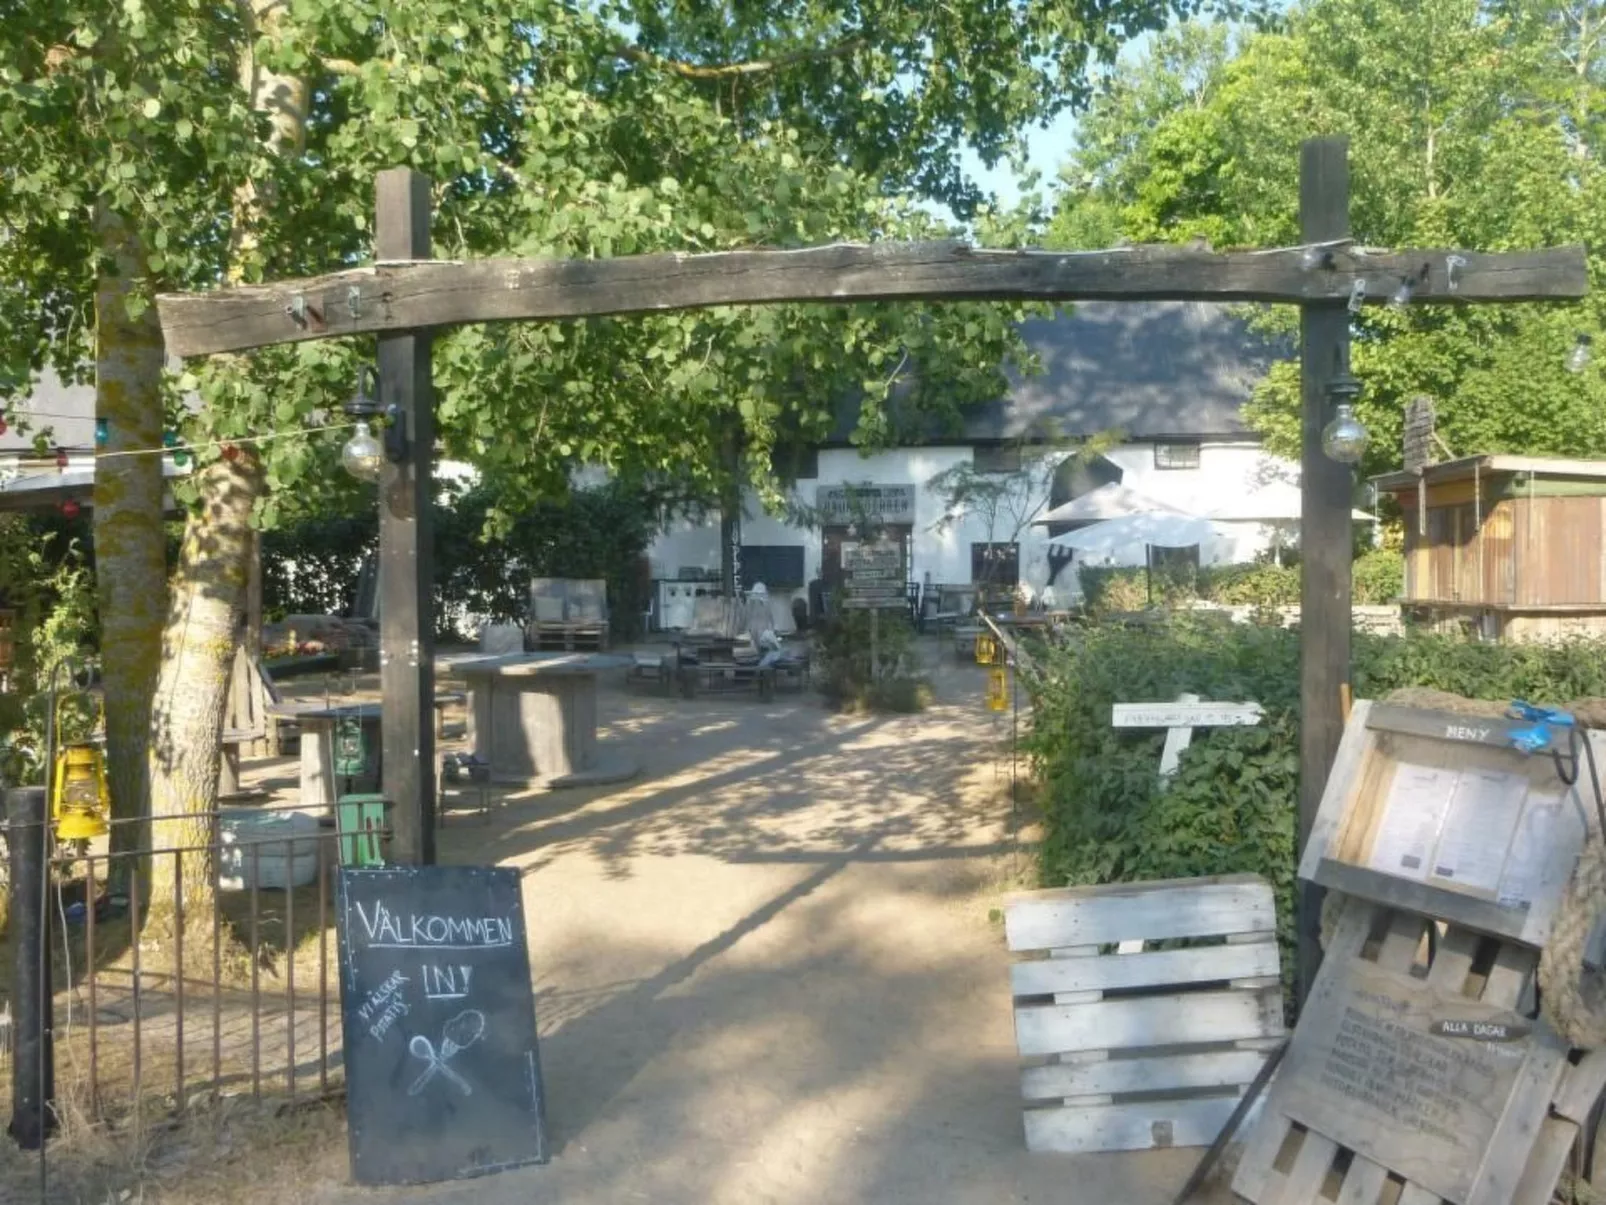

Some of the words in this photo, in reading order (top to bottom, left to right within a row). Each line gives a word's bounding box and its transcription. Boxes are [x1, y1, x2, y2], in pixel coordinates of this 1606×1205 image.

[1446, 725, 1490, 741] MENY
[356, 900, 513, 944] VÄLKOMMEN
[422, 965, 473, 993] IN!
[1442, 1020, 1468, 1033] ALLA
